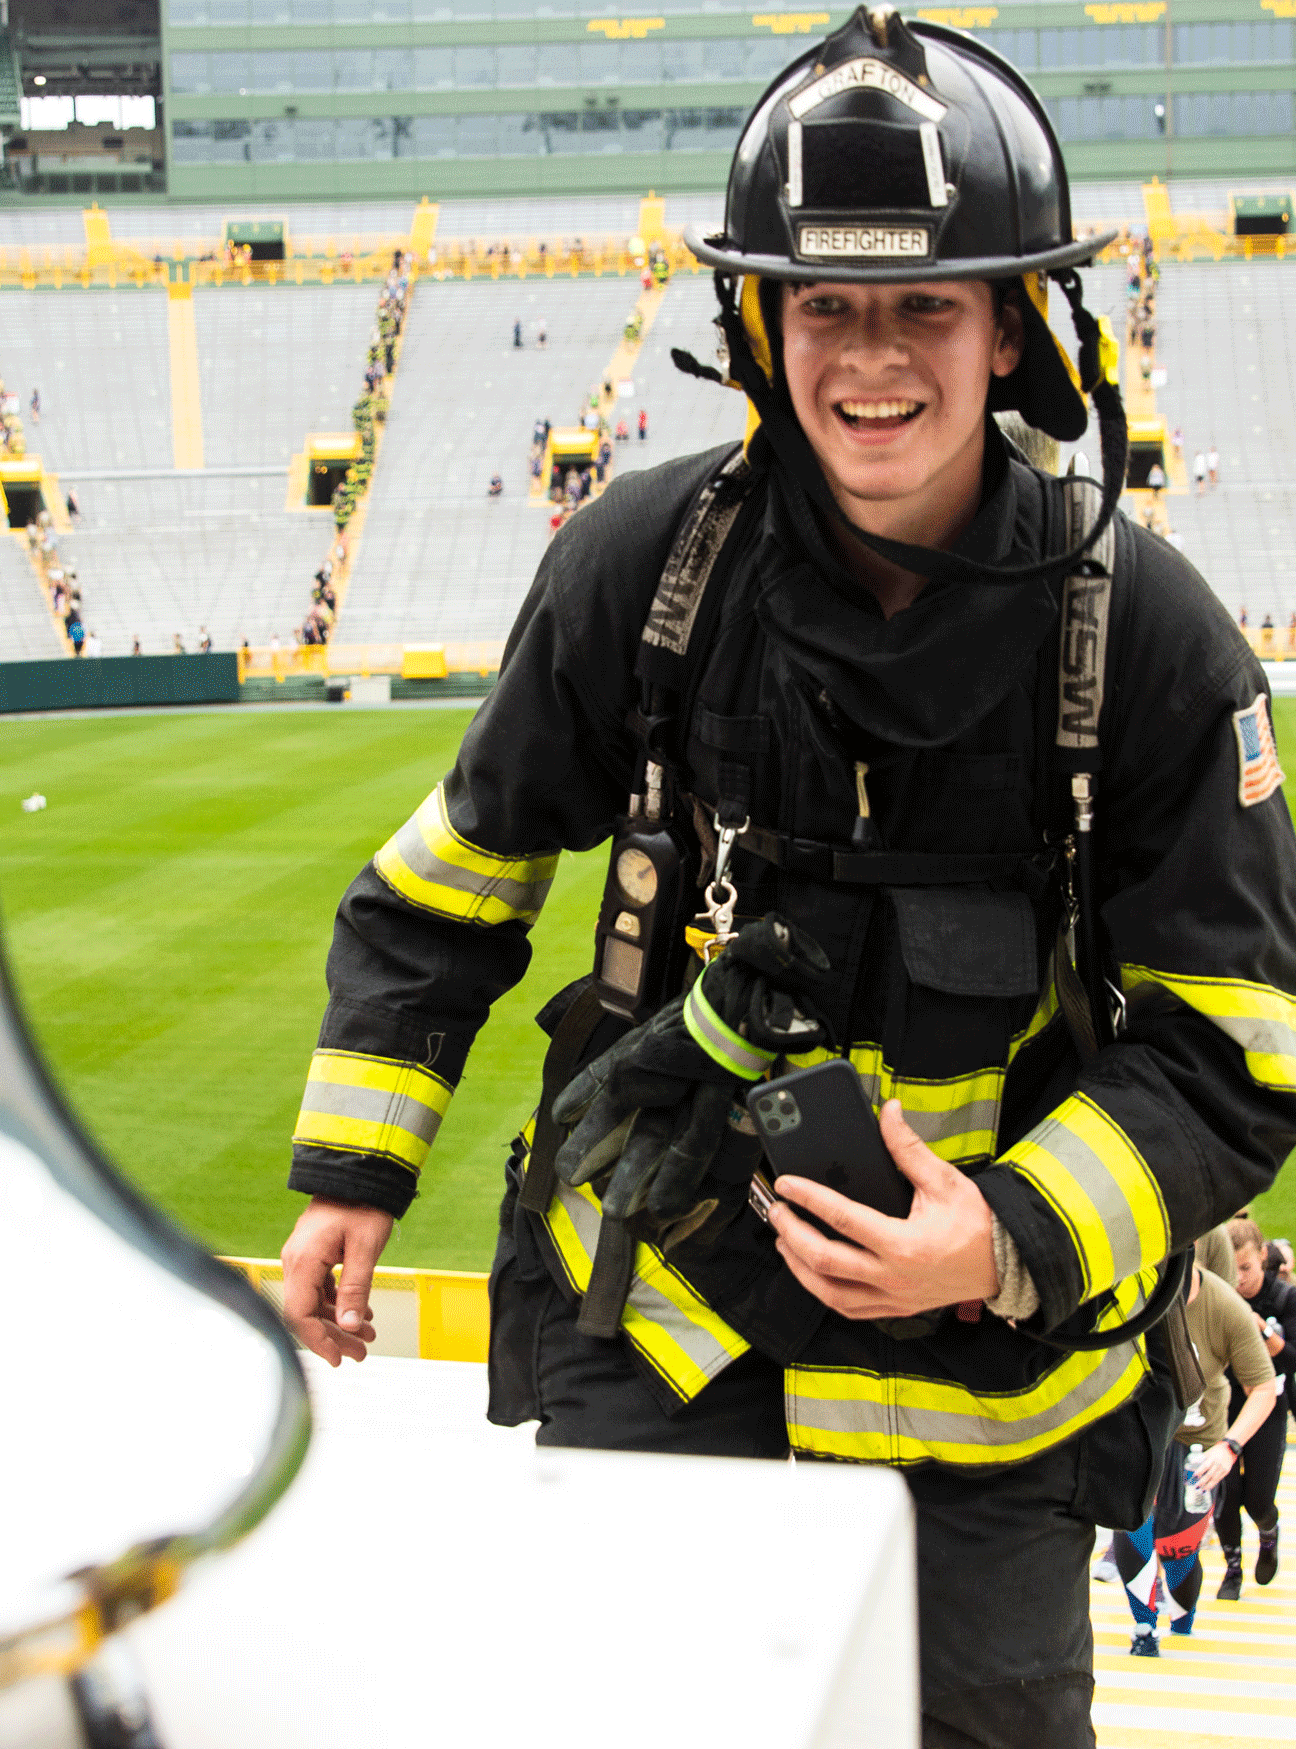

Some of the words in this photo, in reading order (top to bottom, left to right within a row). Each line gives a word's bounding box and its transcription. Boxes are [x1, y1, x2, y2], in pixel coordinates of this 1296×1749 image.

[818, 63, 916, 105] GRAFTON
[805, 231, 923, 251] FIREFIGHTER
[1062, 582, 1106, 737] MSA
